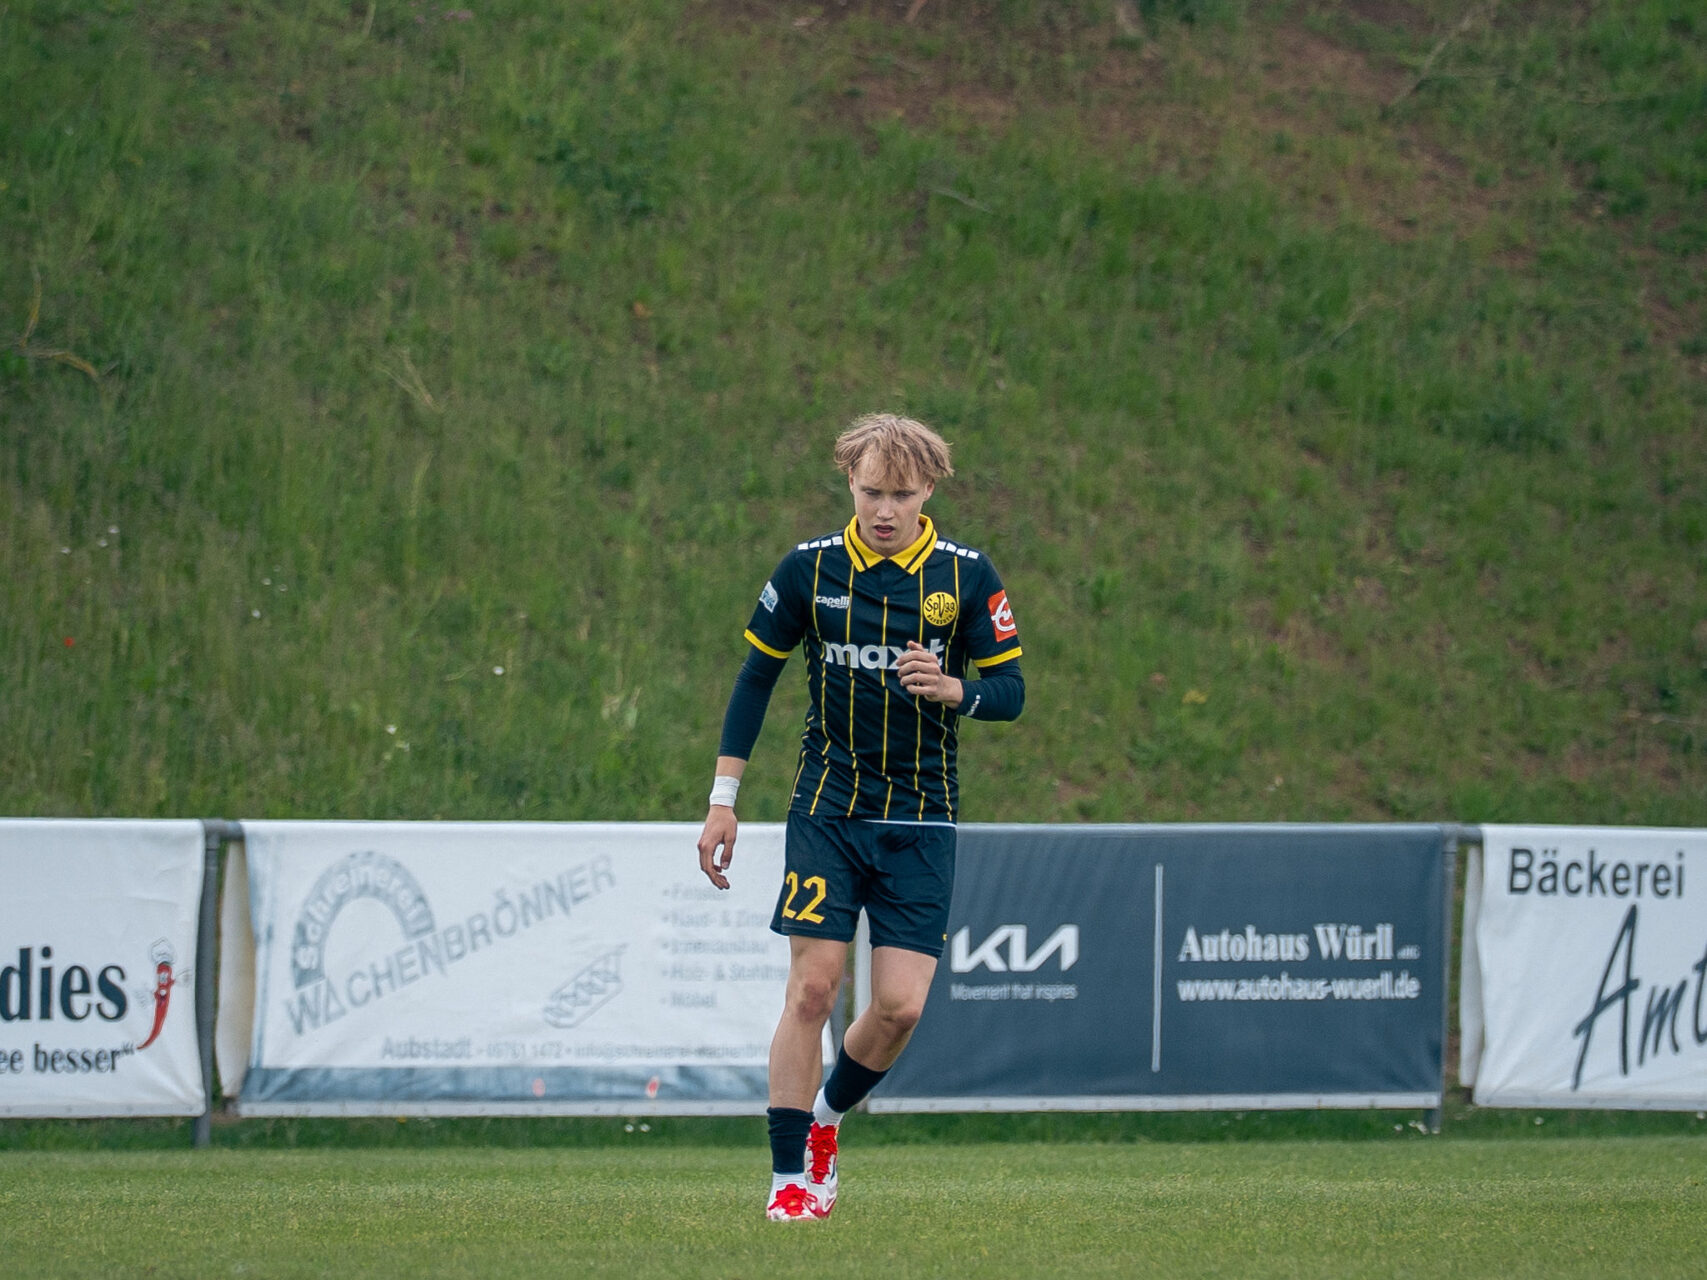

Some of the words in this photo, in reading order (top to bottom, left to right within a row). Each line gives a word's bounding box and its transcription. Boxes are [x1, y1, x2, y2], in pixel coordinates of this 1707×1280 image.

[822, 638, 946, 670] maxt
[1508, 847, 1684, 897] Bäckerei
[782, 871, 827, 924] 22
[286, 853, 616, 1035] WACHENBRÖNNER
[1177, 923, 1310, 962] Autohaus
[0, 946, 127, 1022] dies
[382, 1036, 471, 1060] Aubstadt
